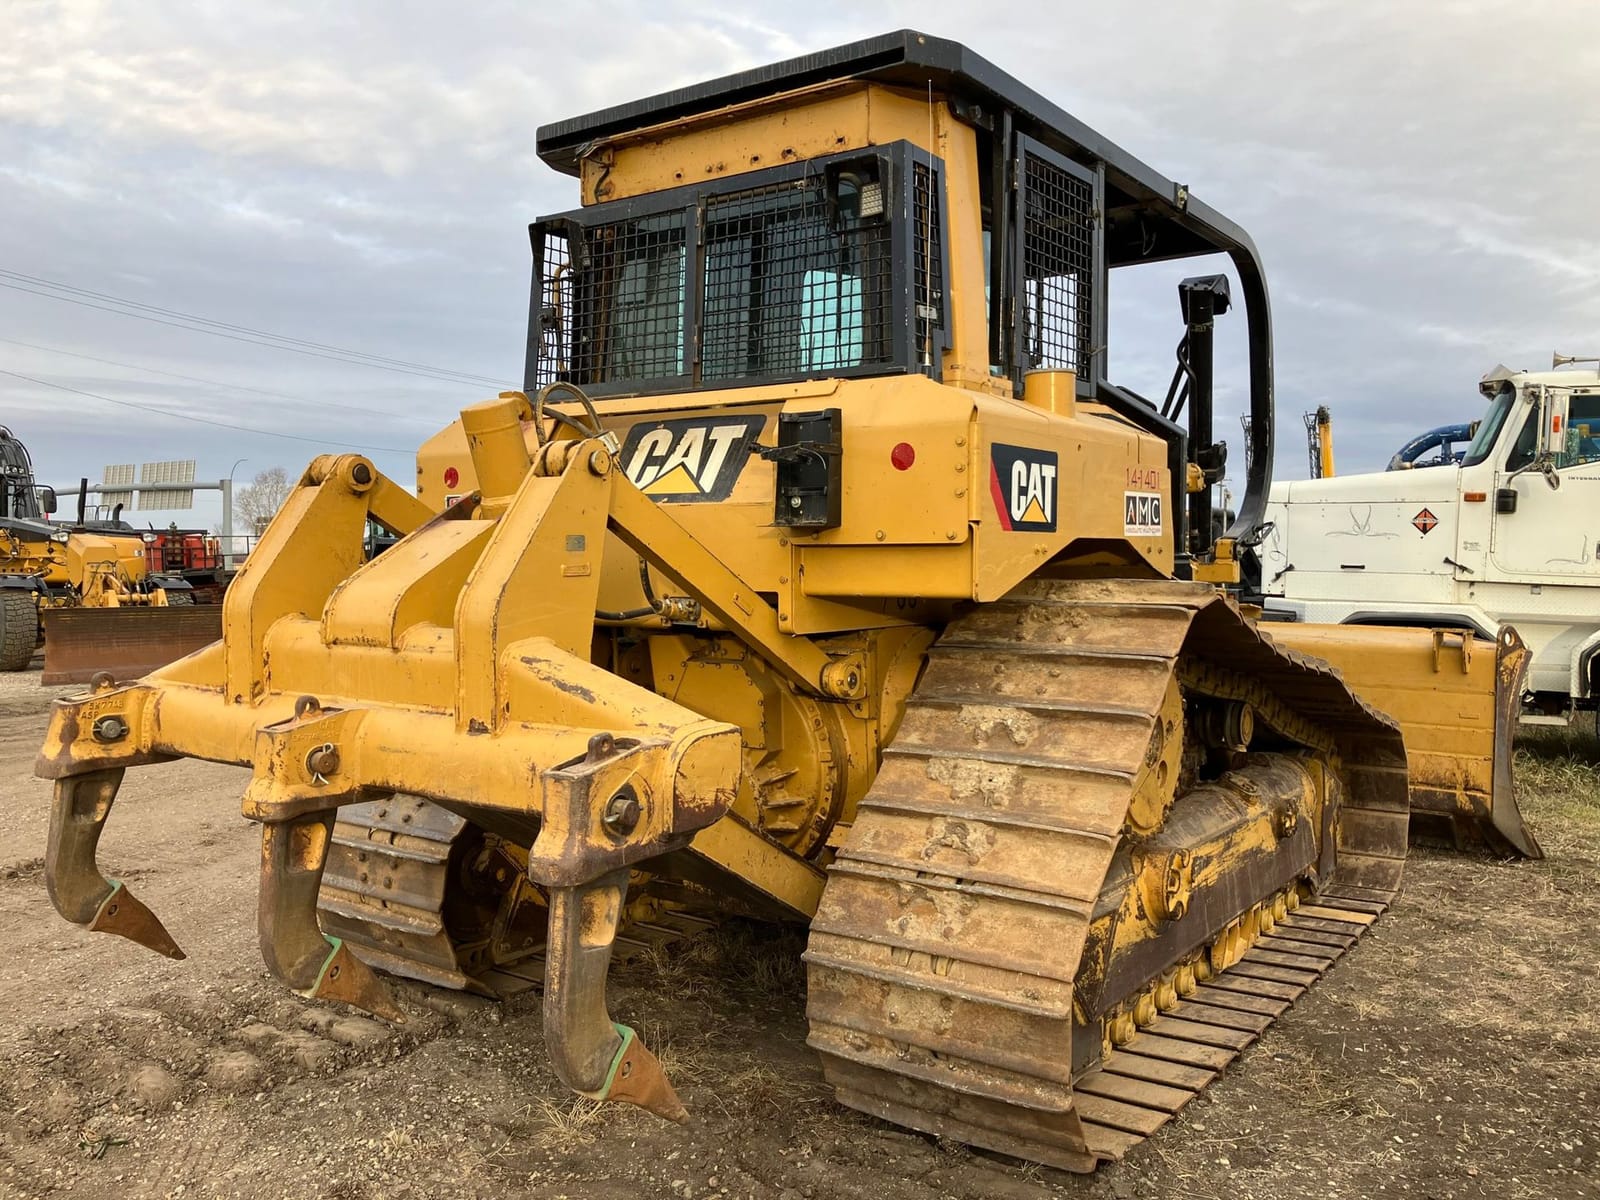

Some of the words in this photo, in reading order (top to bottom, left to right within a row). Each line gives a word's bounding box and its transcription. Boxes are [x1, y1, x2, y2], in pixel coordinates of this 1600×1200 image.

[626, 424, 748, 493] CAT
[1126, 467, 1160, 489] 14-1401
[1011, 459, 1056, 523] CAT
[1126, 498, 1160, 524] AMC
